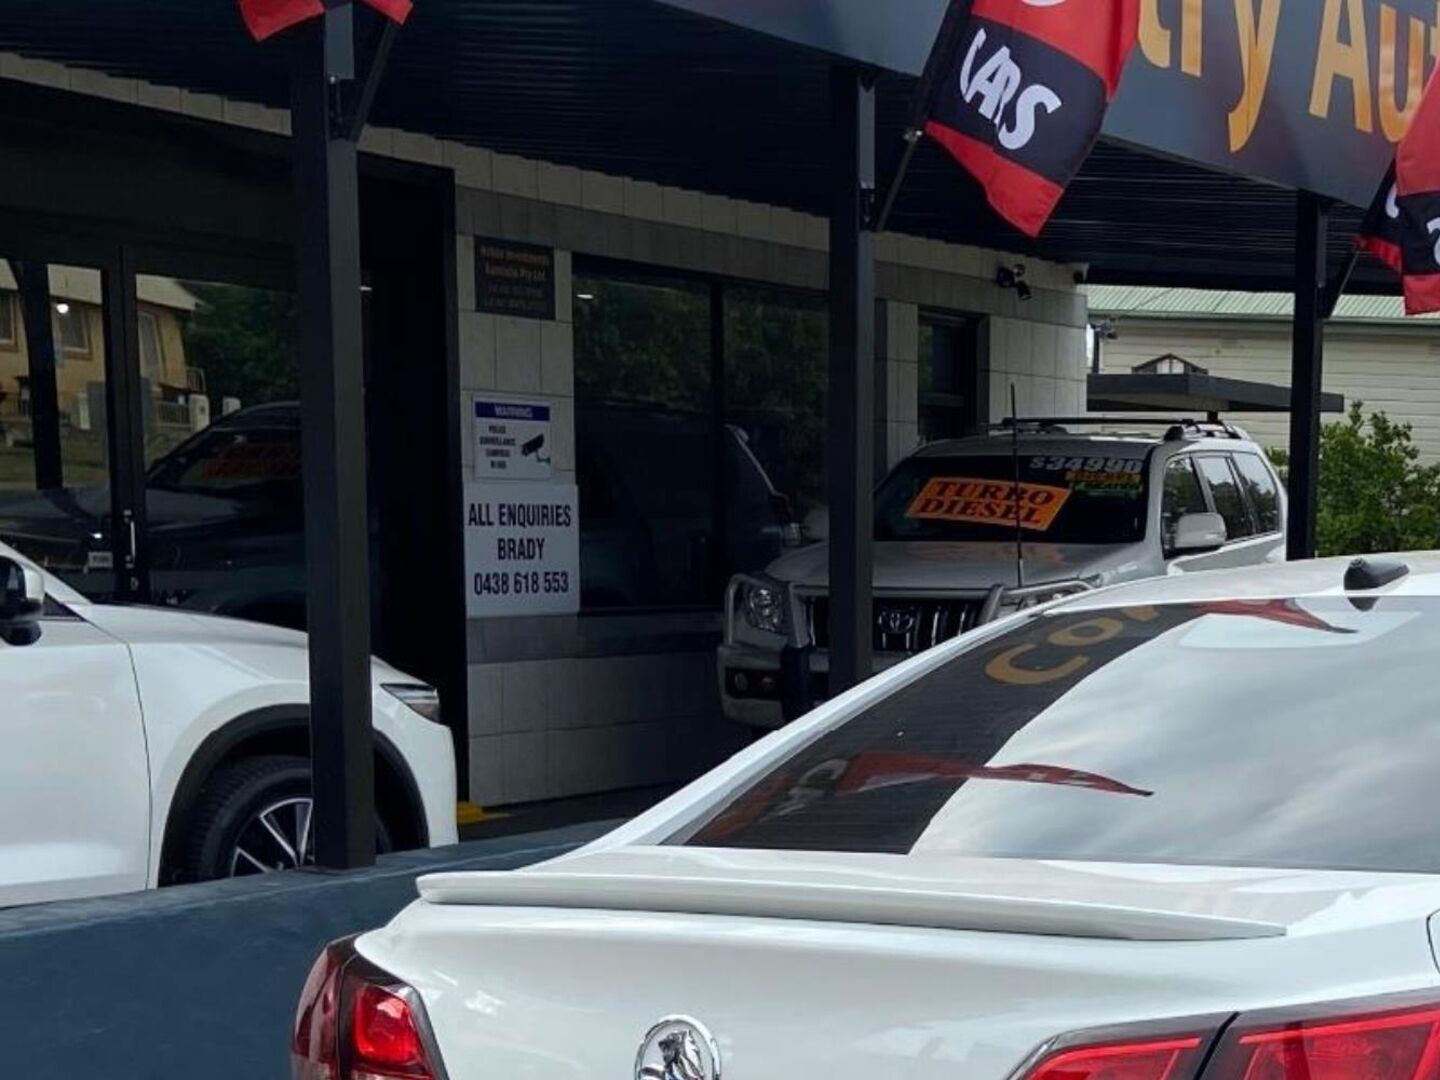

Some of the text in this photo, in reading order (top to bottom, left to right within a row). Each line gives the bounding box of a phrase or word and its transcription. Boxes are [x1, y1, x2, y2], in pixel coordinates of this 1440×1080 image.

[935, 481, 1055, 506] TURBO
[468, 503, 571, 528] ALL ENQUIRIES
[918, 497, 1042, 525] DIESEL
[497, 537, 545, 560] BRADY
[474, 570, 569, 596] 0438 618 553
